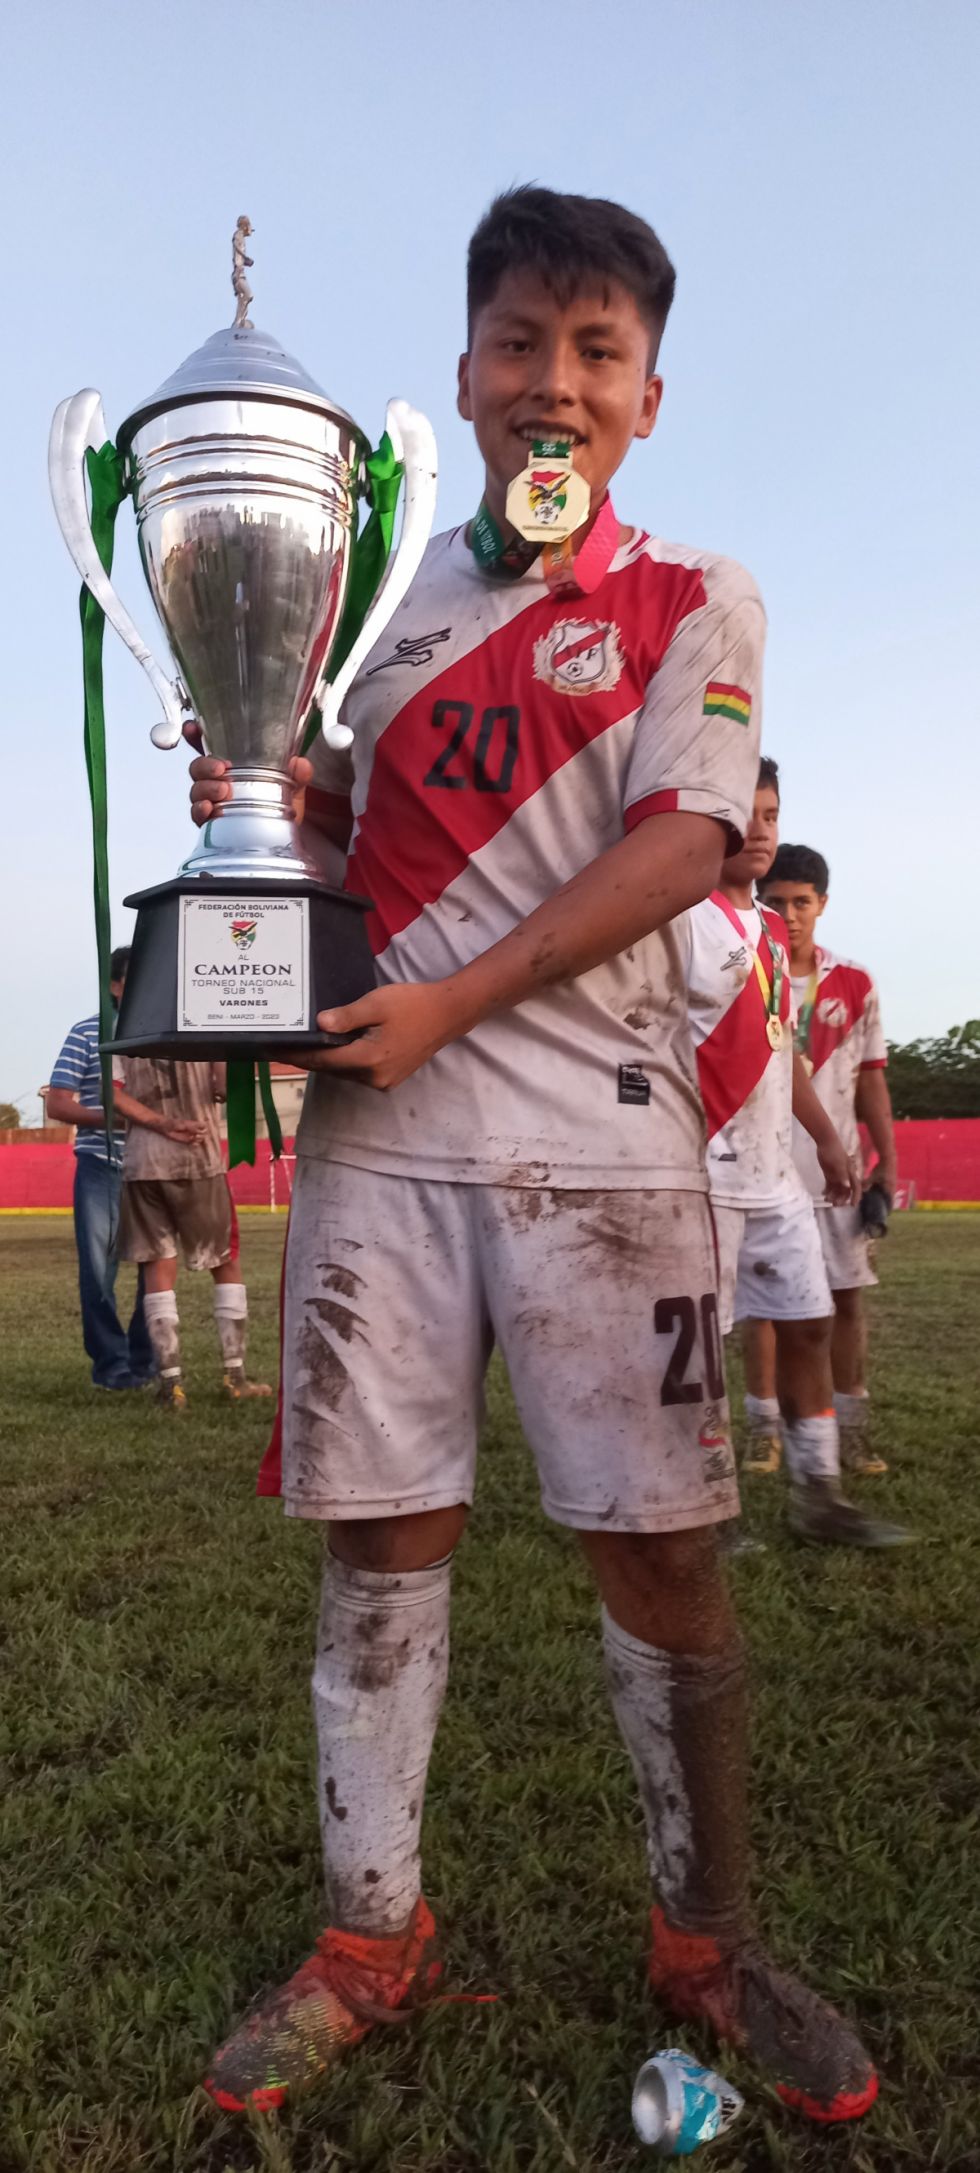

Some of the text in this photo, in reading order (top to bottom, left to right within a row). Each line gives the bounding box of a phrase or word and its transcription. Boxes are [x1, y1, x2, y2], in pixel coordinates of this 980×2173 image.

[423, 699, 521, 793] 20
[198, 903, 246, 911] FEDERACIÓN
[235, 910, 265, 918] FÚTBOL
[194, 964, 292, 976] CAMPEON
[240, 979, 296, 987] NACIONAL
[654, 1293, 726, 1407] 20
